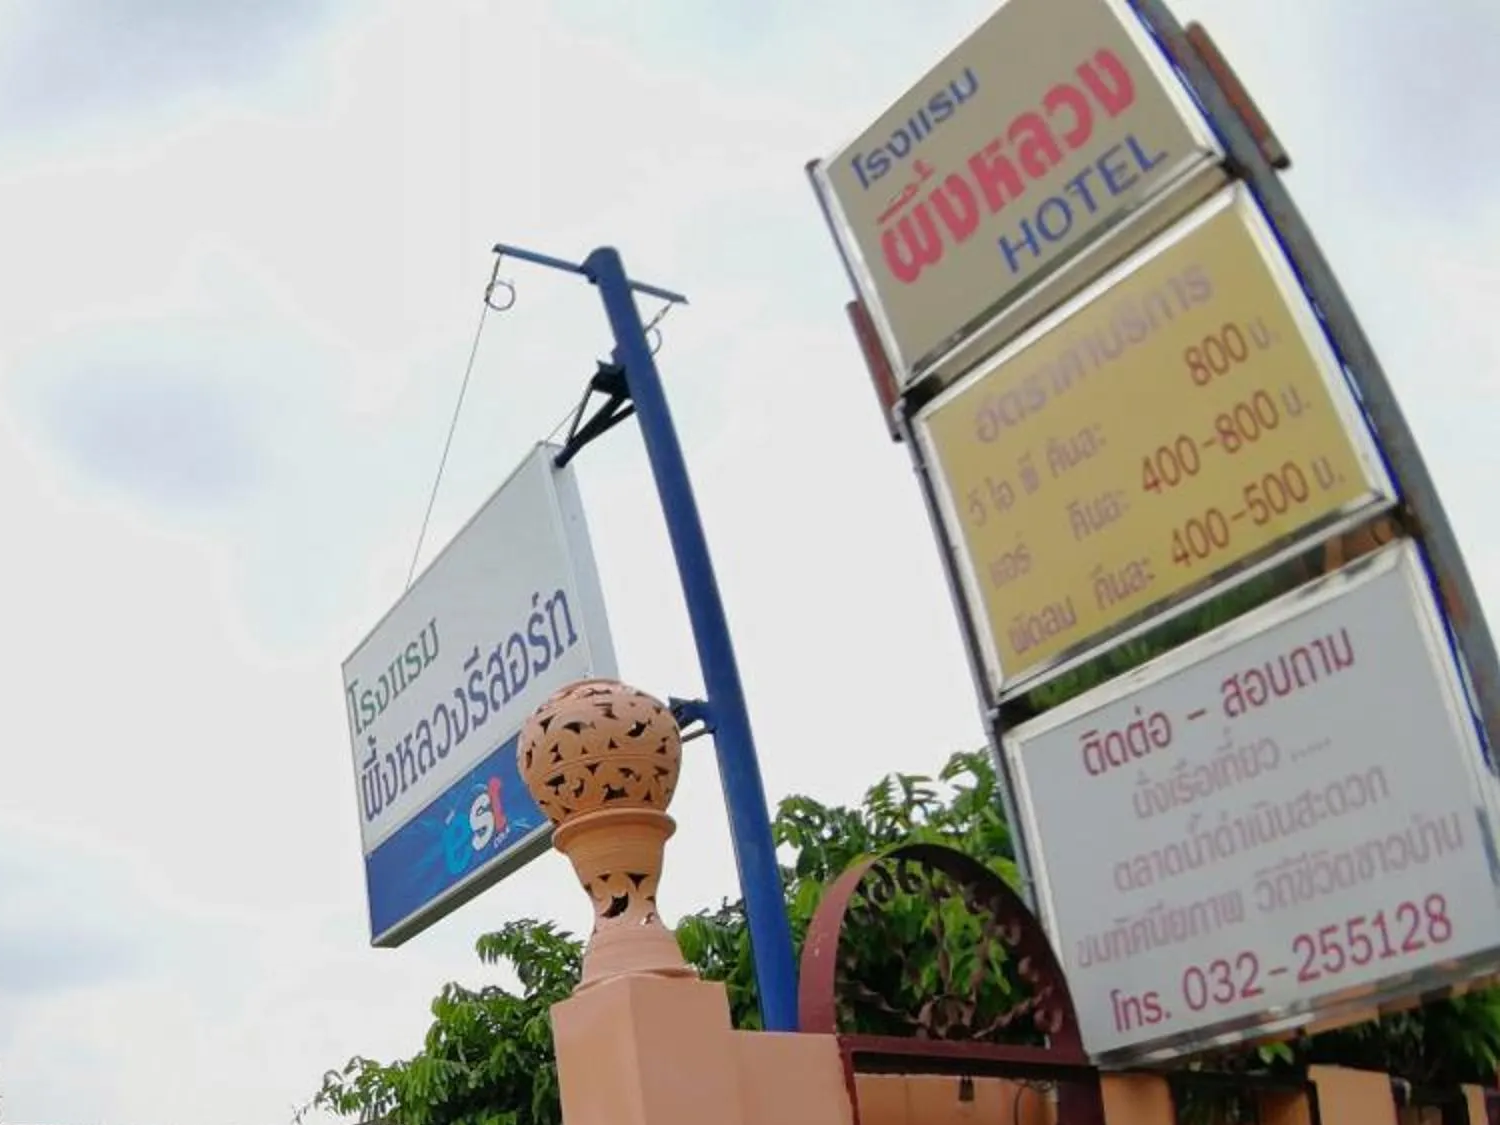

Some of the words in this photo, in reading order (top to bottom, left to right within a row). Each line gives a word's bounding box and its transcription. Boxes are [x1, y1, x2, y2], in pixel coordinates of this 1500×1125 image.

[851, 67, 979, 190] โรงแรม
[877, 47, 1136, 284] ผึ้งหลวง
[998, 134, 1169, 273] HOTEL
[1183, 321, 1249, 387] 800
[1141, 389, 1281, 496] 400-800
[1171, 461, 1309, 568] 400-500
[347, 616, 440, 736] โรงแรม
[1079, 705, 1172, 777] ติดต่อ
[1220, 627, 1355, 719] สอบถาม
[1108, 987, 1173, 1033] โทร.
[1182, 893, 1453, 1012] 032-255128
